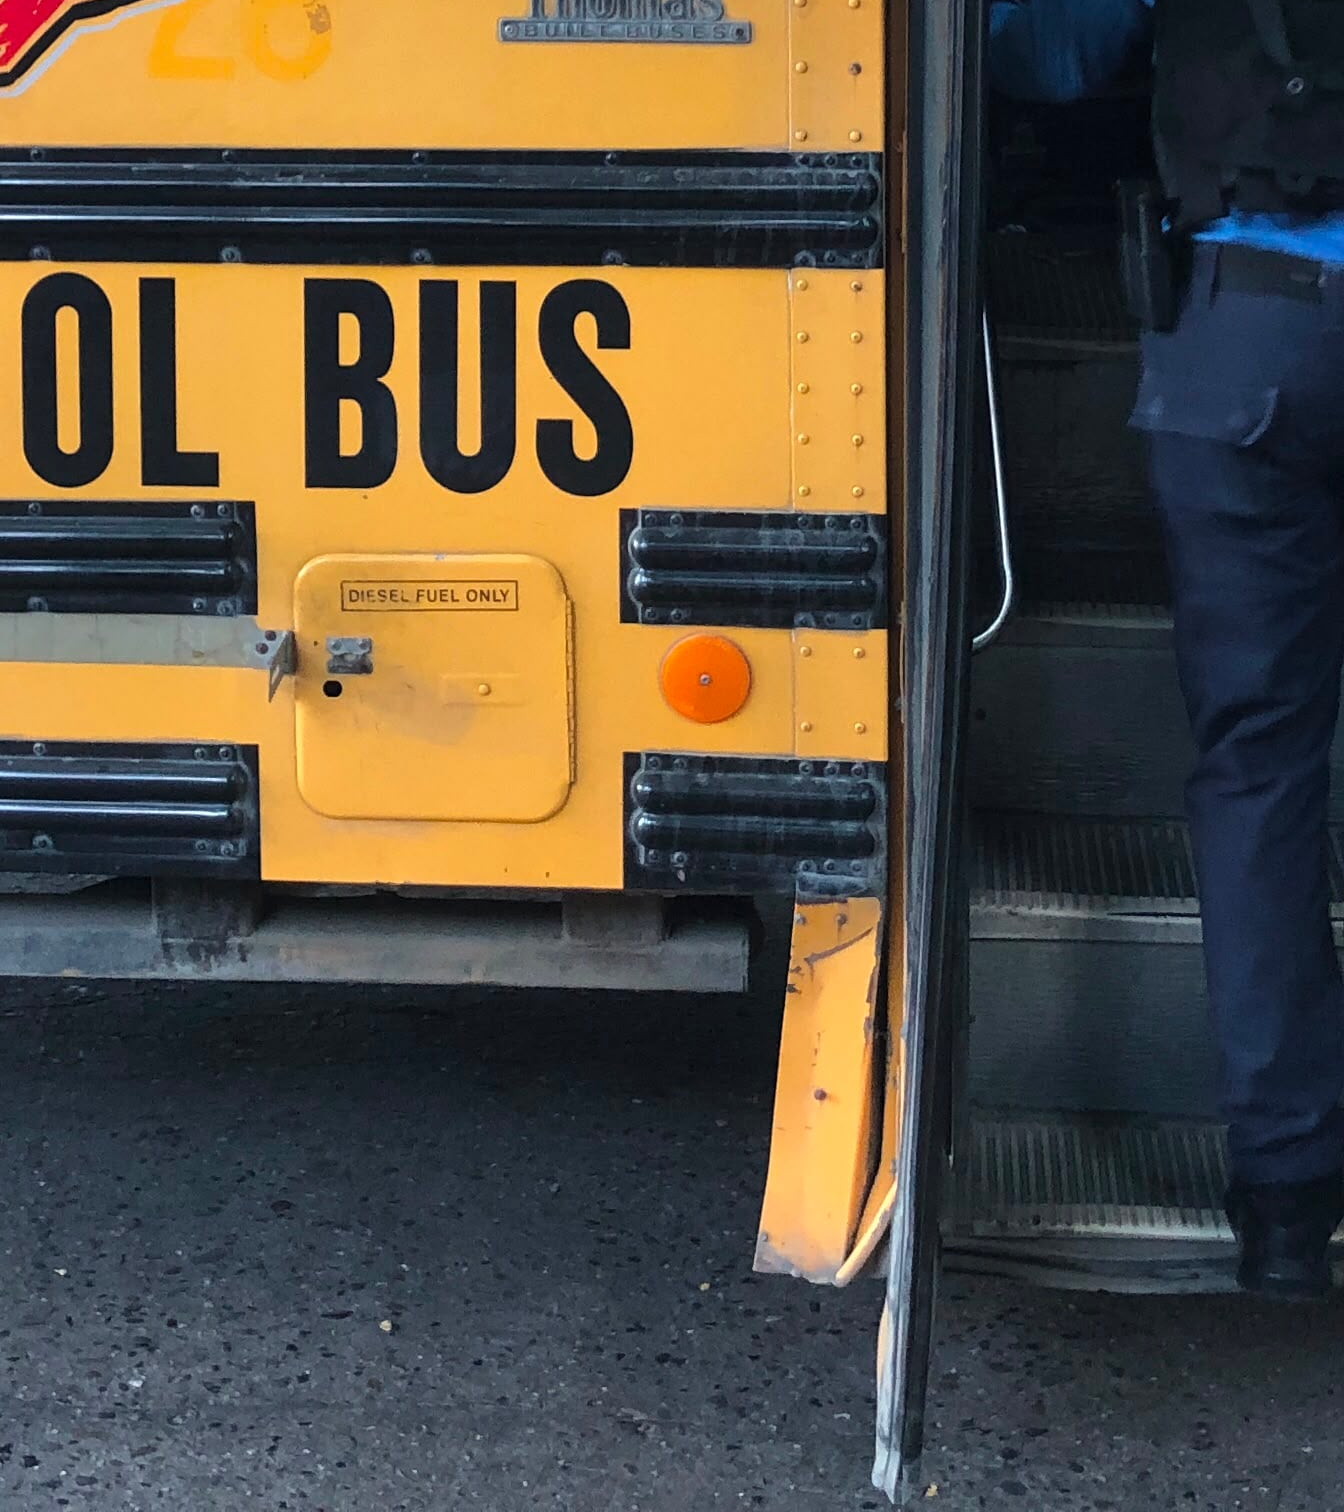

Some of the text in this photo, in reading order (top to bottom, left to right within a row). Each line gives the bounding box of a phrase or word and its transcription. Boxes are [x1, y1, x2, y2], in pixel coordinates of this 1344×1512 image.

[303, 277, 634, 498] BUS
[348, 588, 510, 604] DIESEL FUEL ONLY
